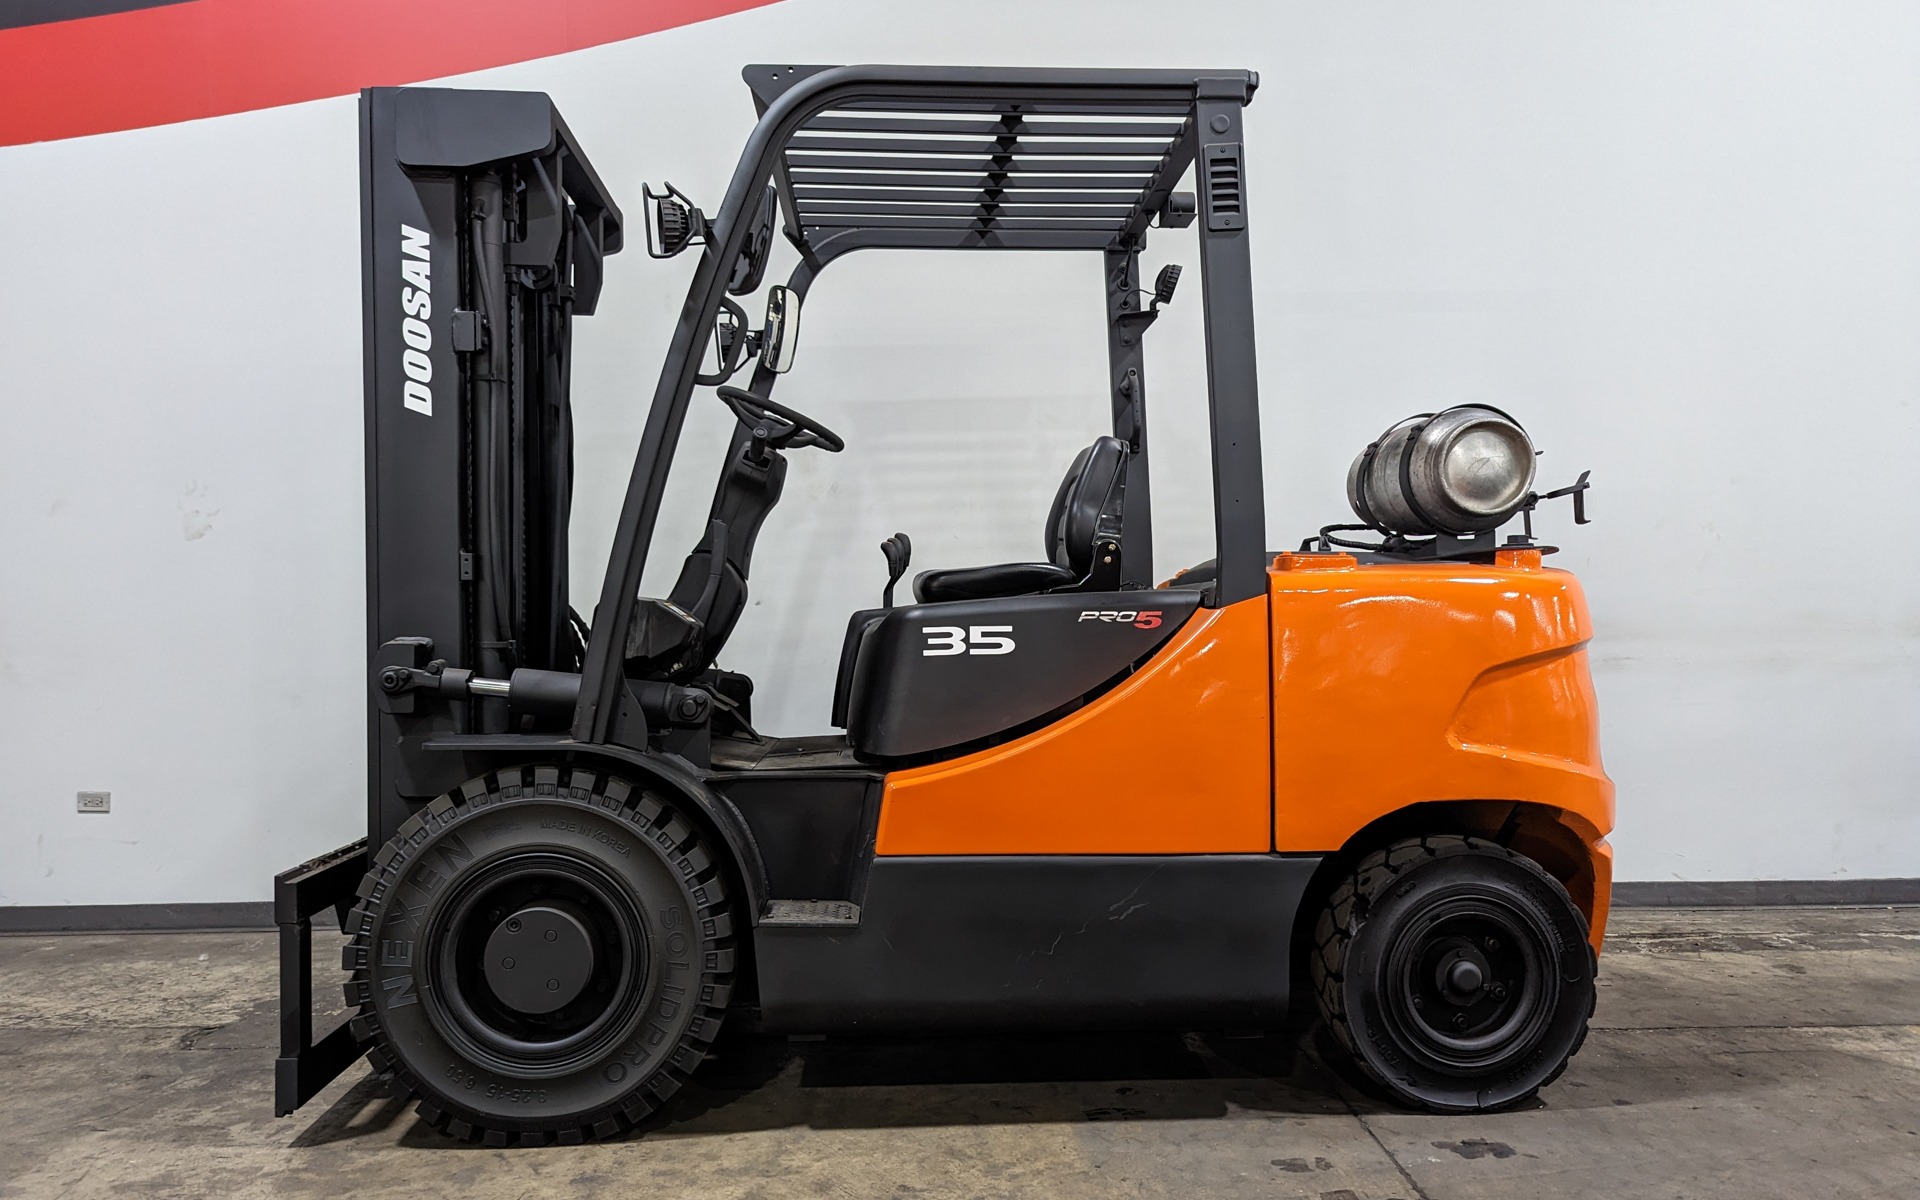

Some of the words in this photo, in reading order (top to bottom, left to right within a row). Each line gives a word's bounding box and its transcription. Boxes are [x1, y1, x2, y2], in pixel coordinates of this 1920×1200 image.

[401, 224, 432, 416] DOOSAN
[922, 625, 1016, 656] 35
[540, 820, 576, 832] MADE
[578, 824, 592, 836] IN
[591, 830, 631, 858] KOREA
[381, 831, 476, 1010] NEXEN
